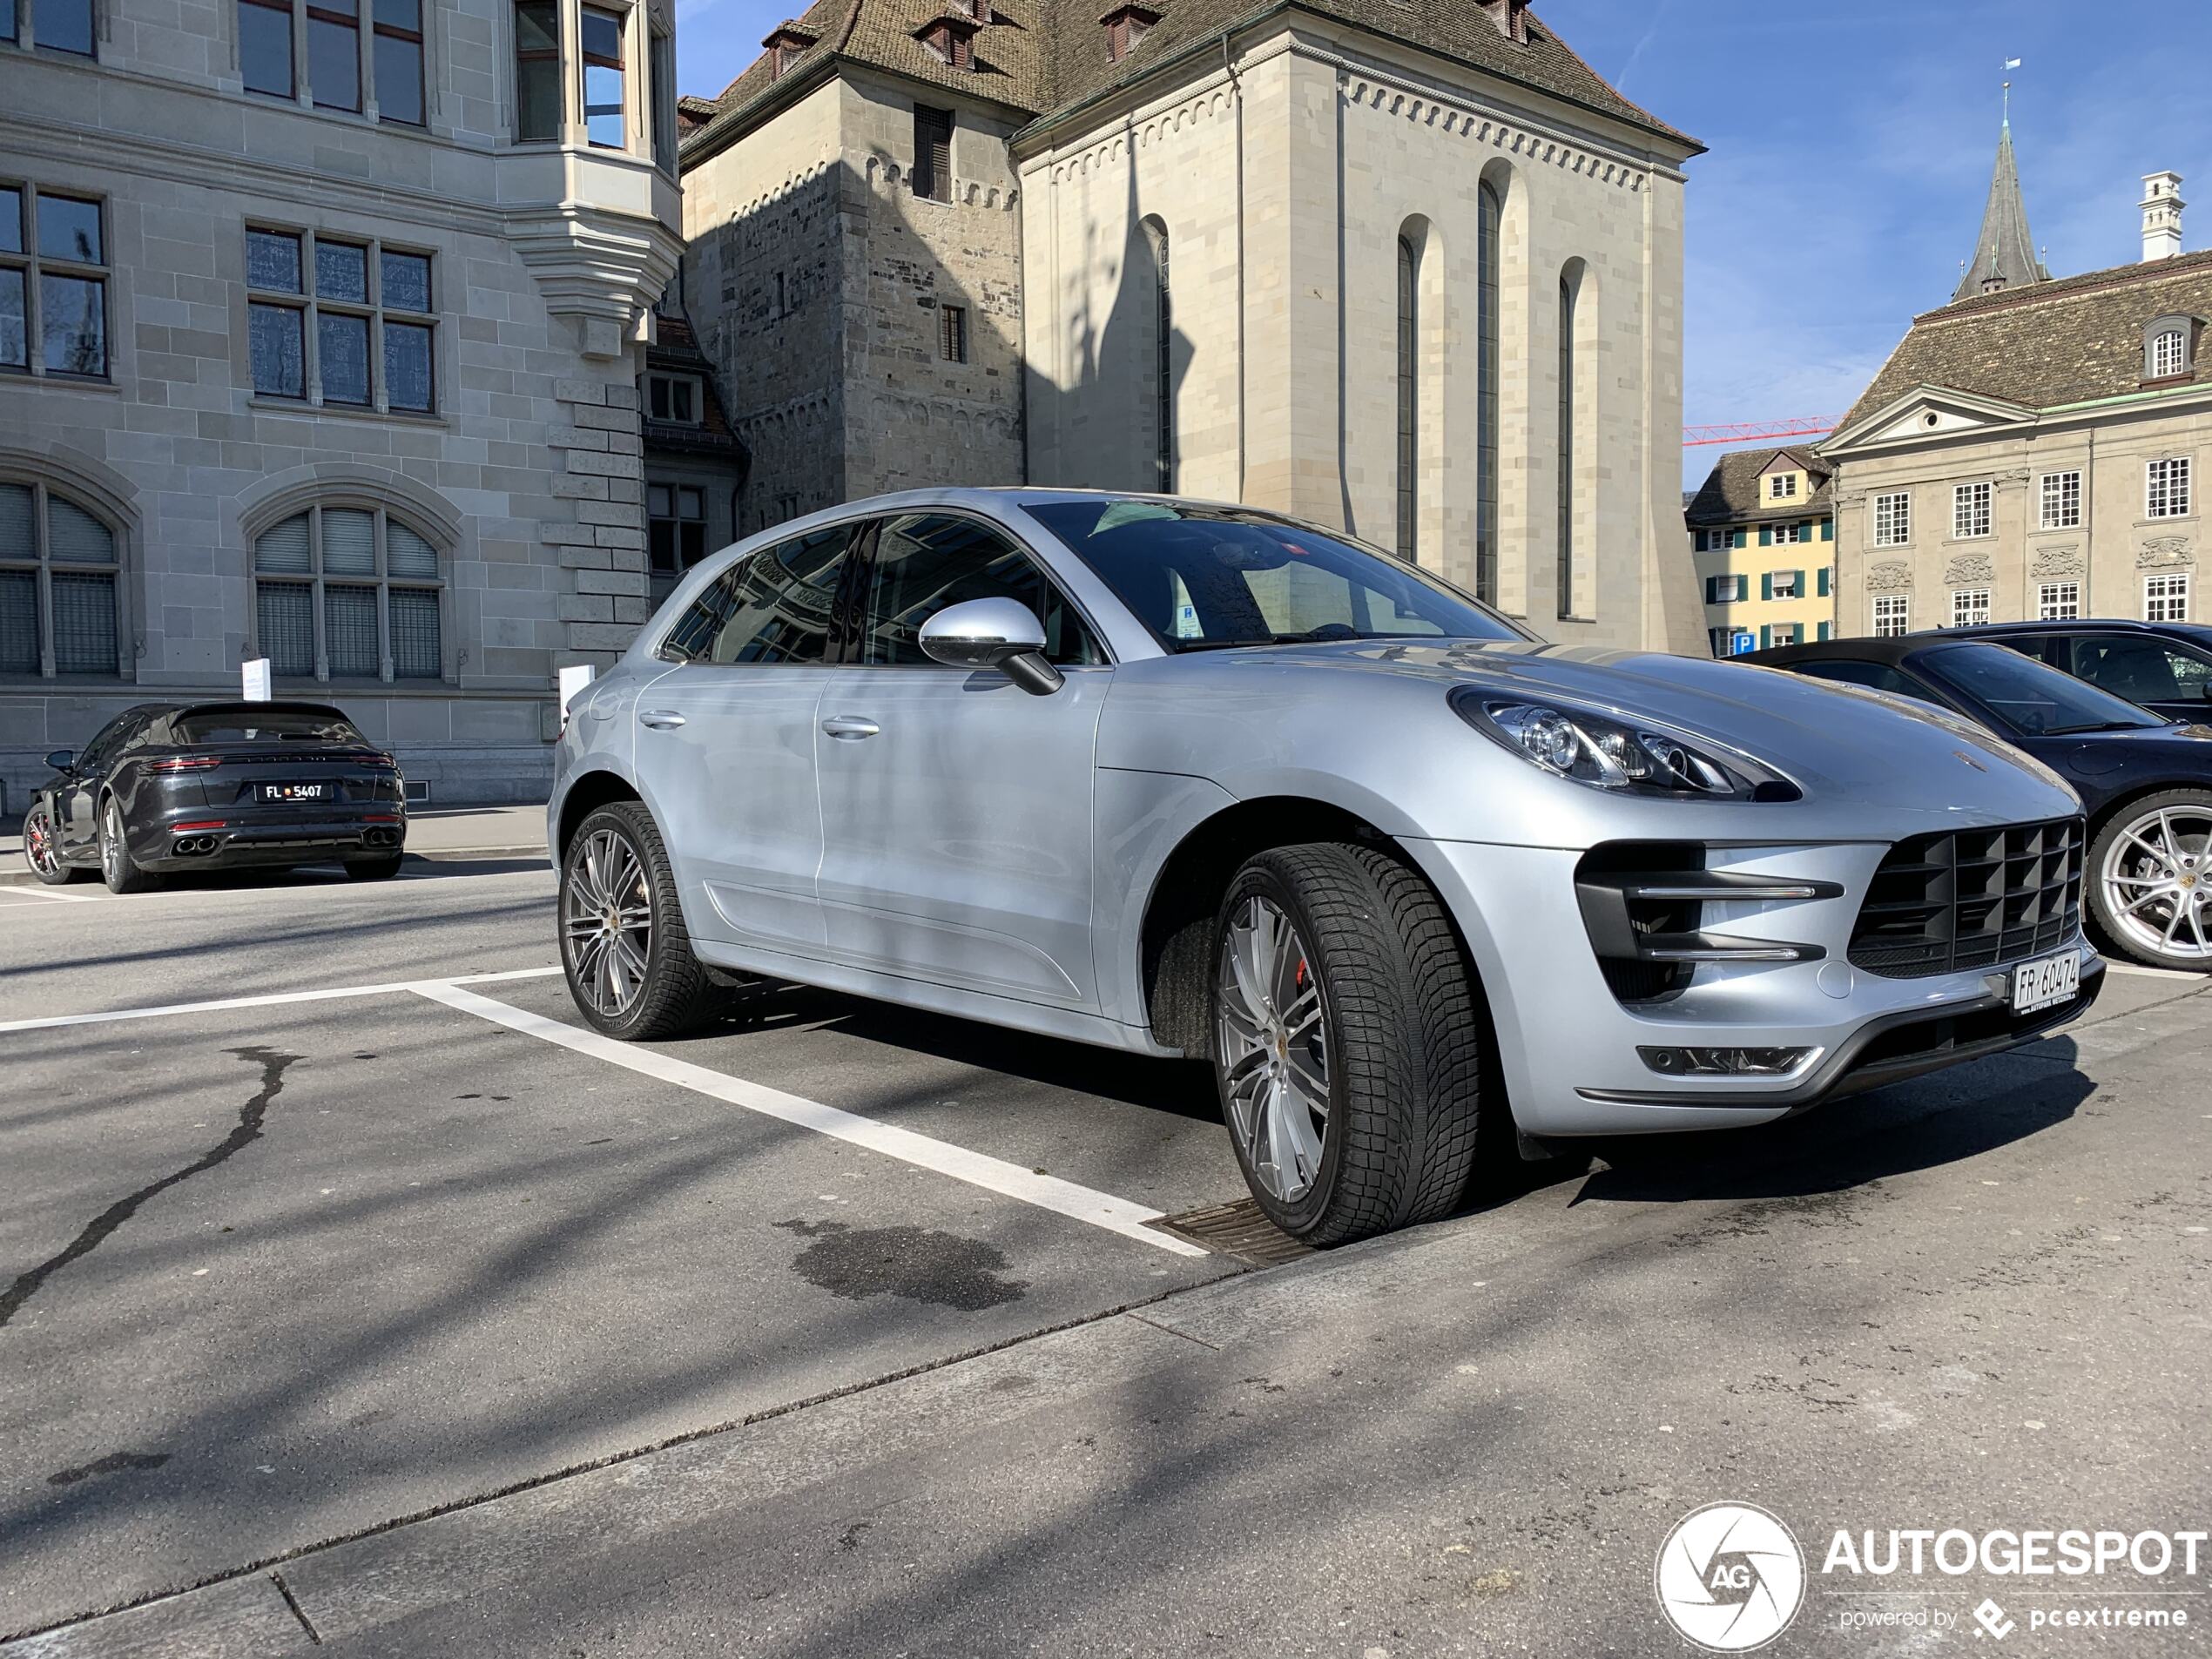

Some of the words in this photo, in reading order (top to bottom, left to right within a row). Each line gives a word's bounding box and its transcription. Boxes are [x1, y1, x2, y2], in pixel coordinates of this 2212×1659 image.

[1741, 637, 1750, 652] P
[266, 786, 282, 798] FL
[293, 785, 322, 798] 5407
[2019, 968, 2035, 1003] FR
[2041, 957, 2076, 996] 60474
